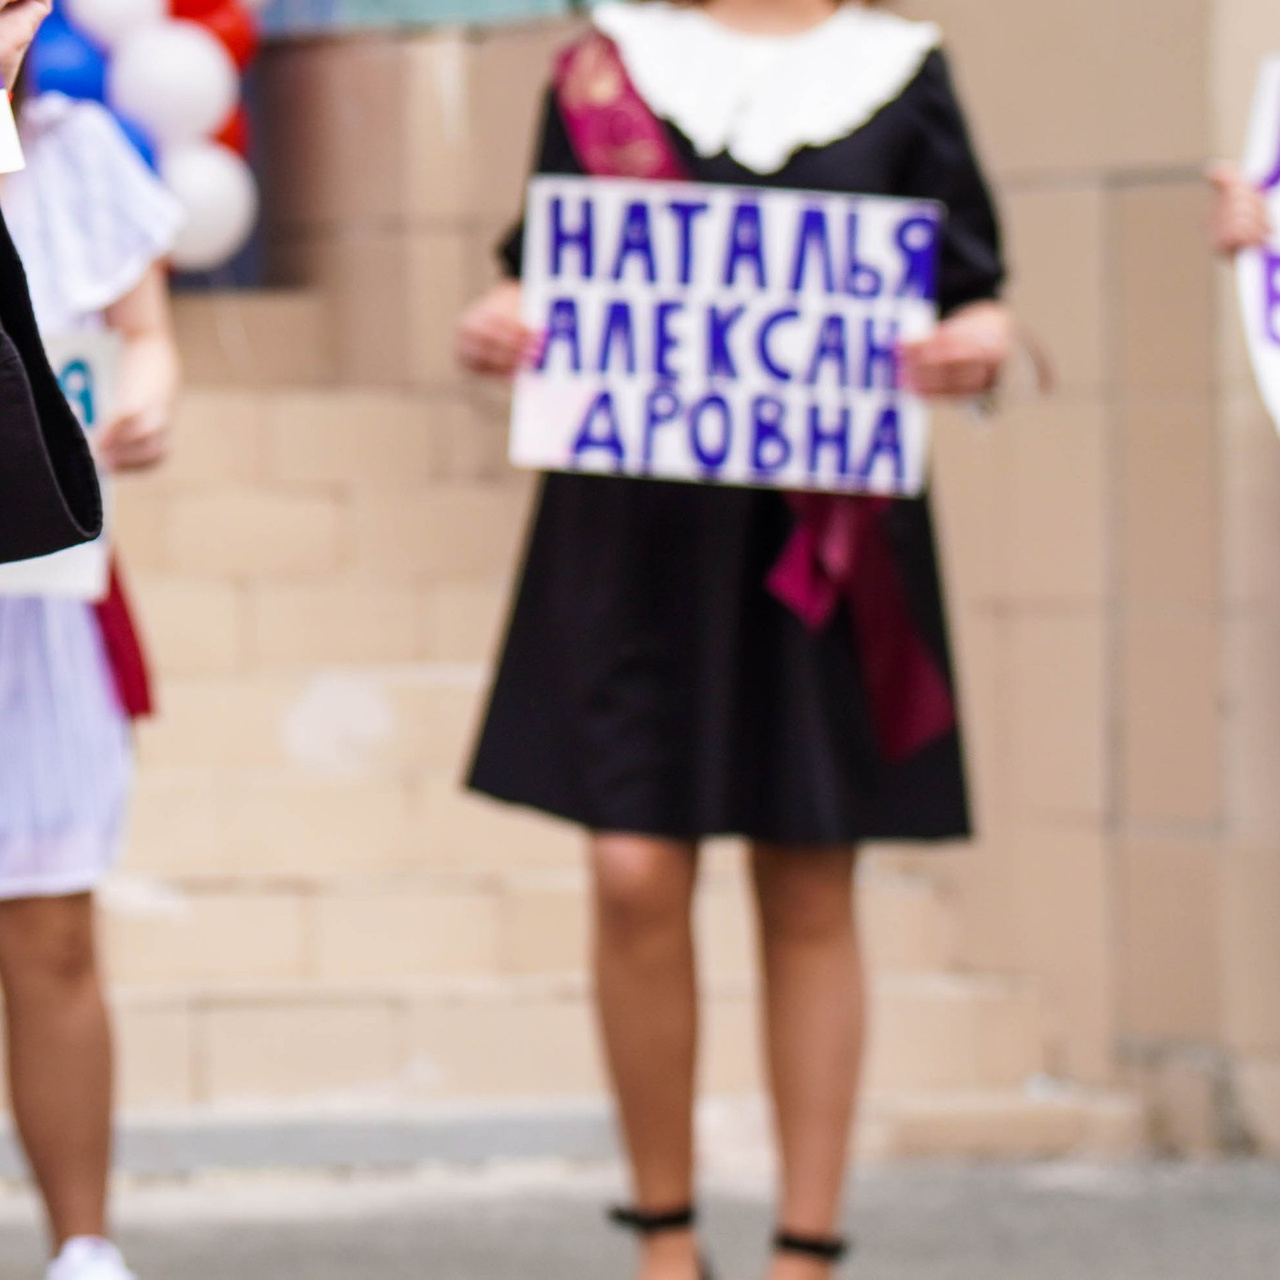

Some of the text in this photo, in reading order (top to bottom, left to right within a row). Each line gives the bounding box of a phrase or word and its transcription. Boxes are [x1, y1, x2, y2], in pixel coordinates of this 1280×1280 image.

[549, 195, 939, 299] НАТАЛЬЯ
[536, 298, 899, 390] АЛЕКСАН
[571, 386, 905, 484] ДРОВНА
